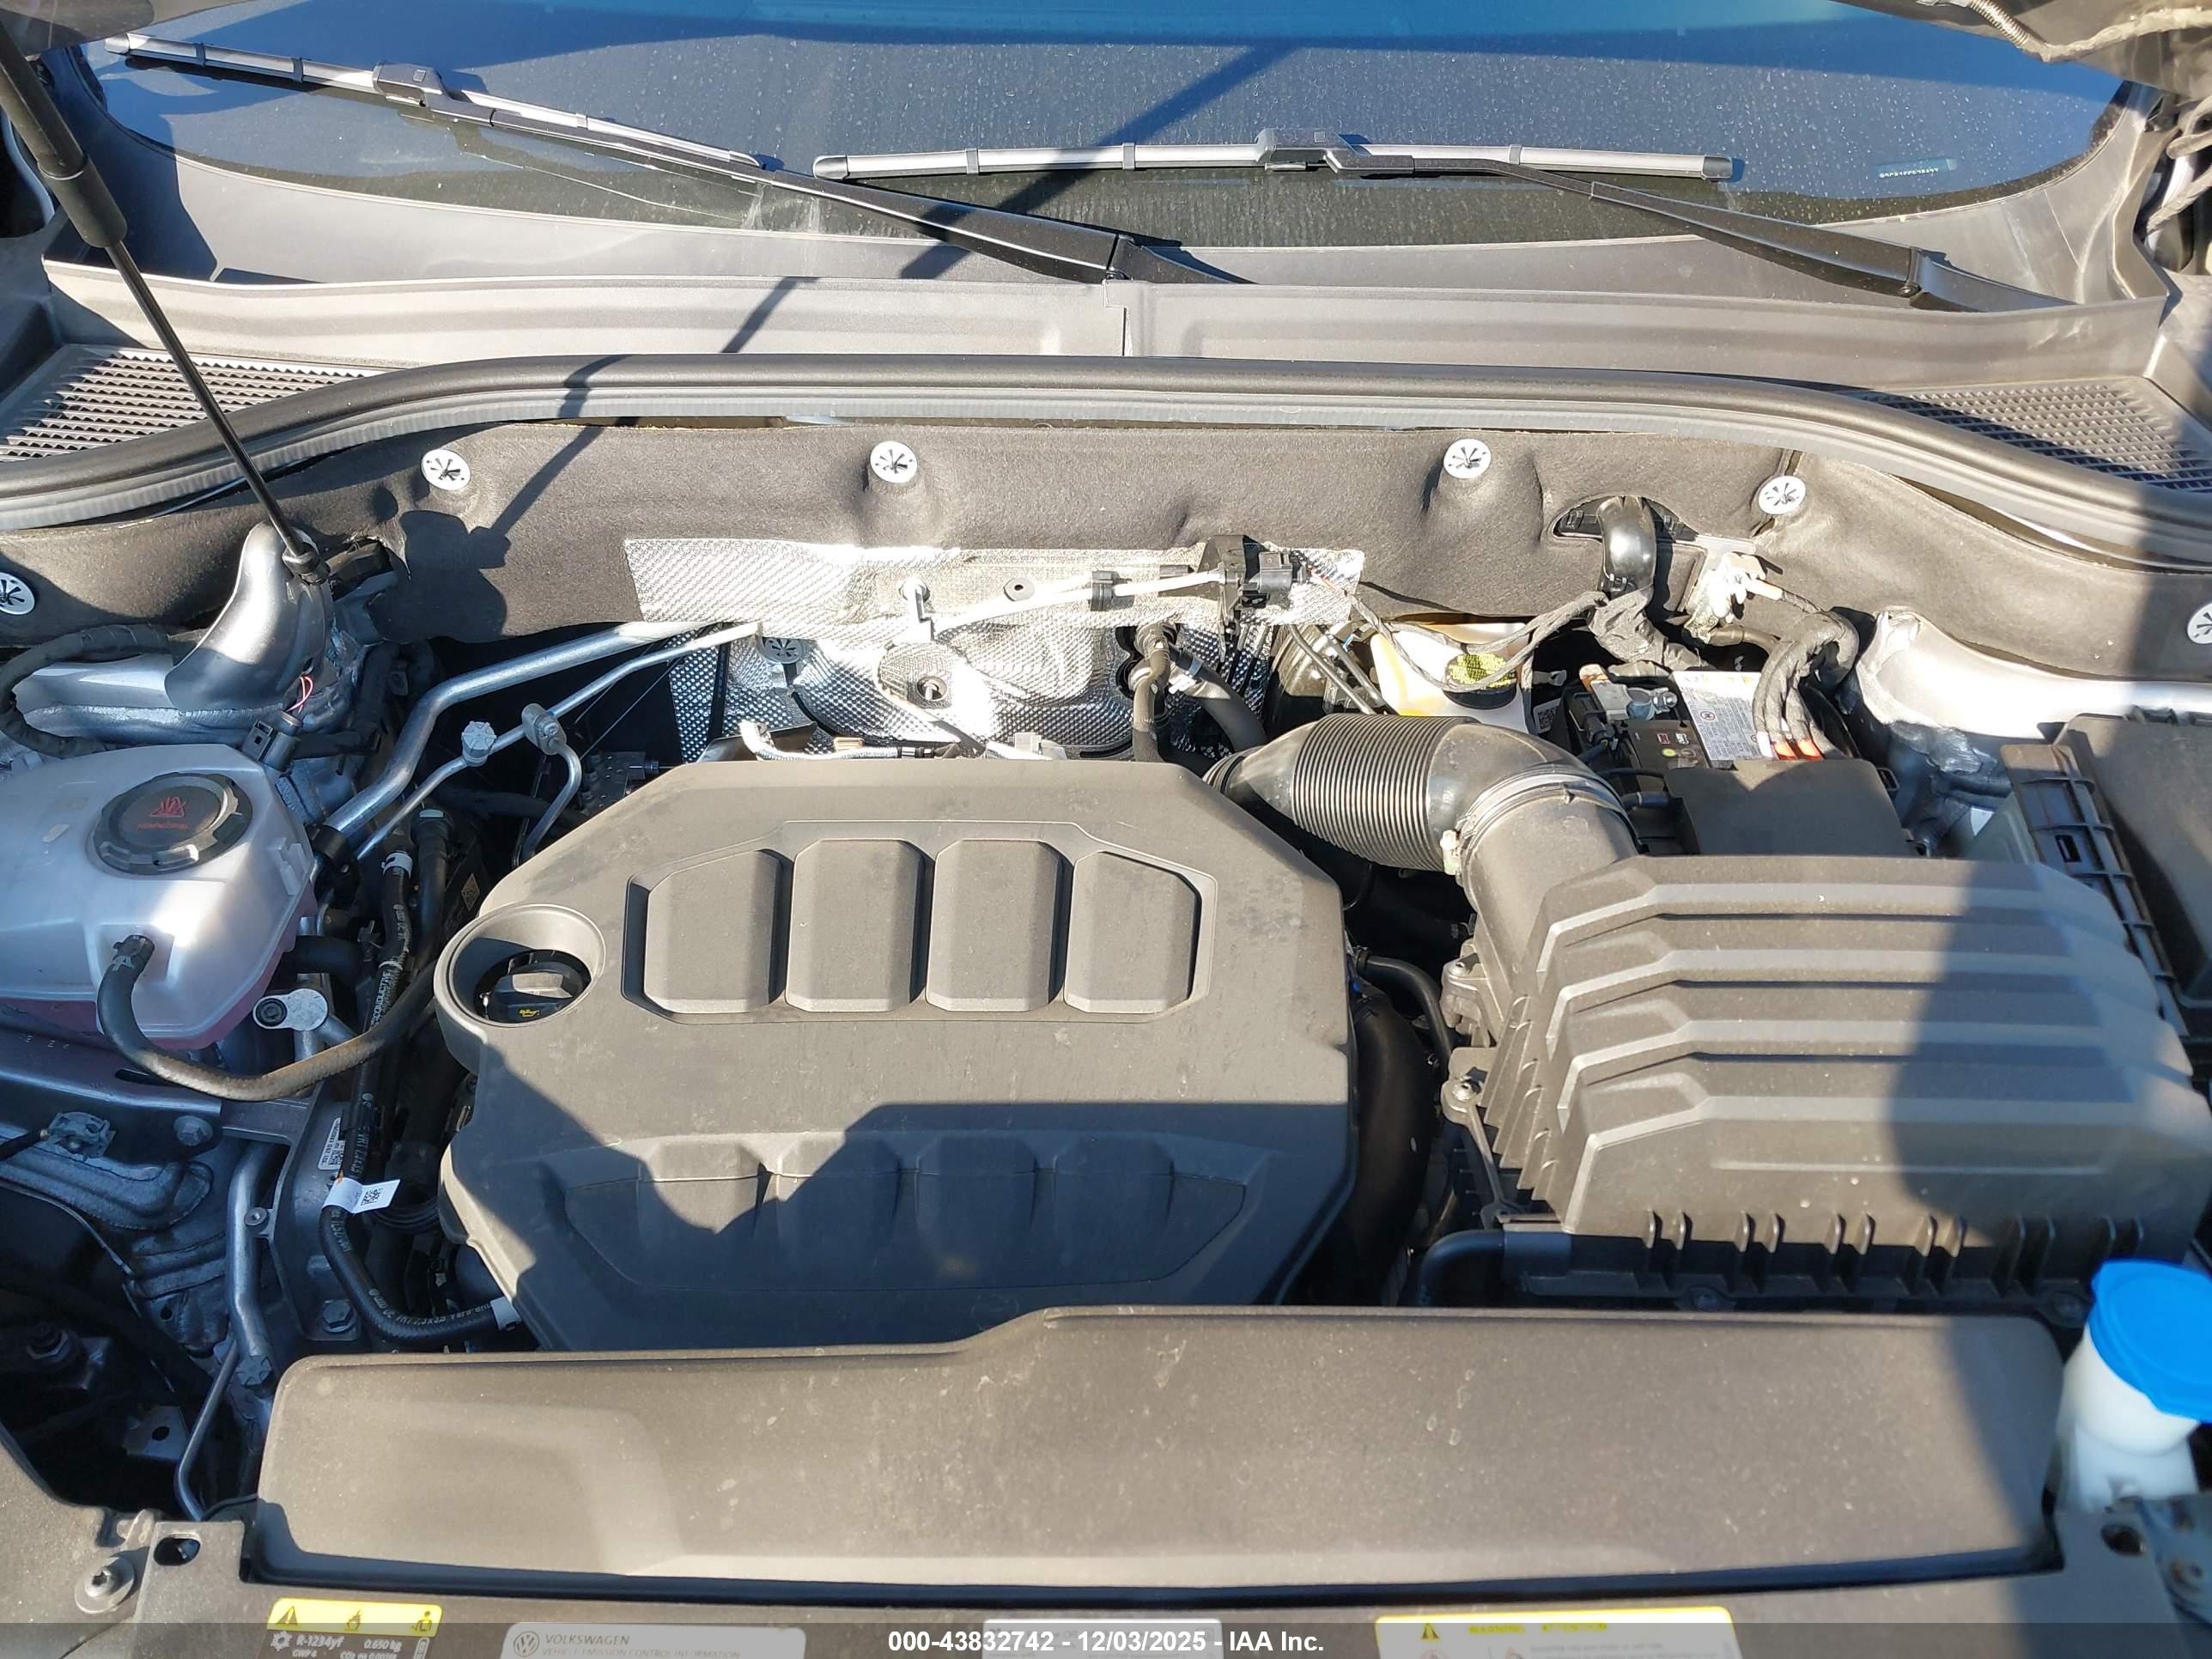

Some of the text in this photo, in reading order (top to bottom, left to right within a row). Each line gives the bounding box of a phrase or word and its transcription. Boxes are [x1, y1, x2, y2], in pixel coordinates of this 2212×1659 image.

[295, 1634, 344, 1650] R-1234yf
[545, 1634, 630, 1646] VOLKSWAGEN
[629, 1648, 671, 1657] CONTROL
